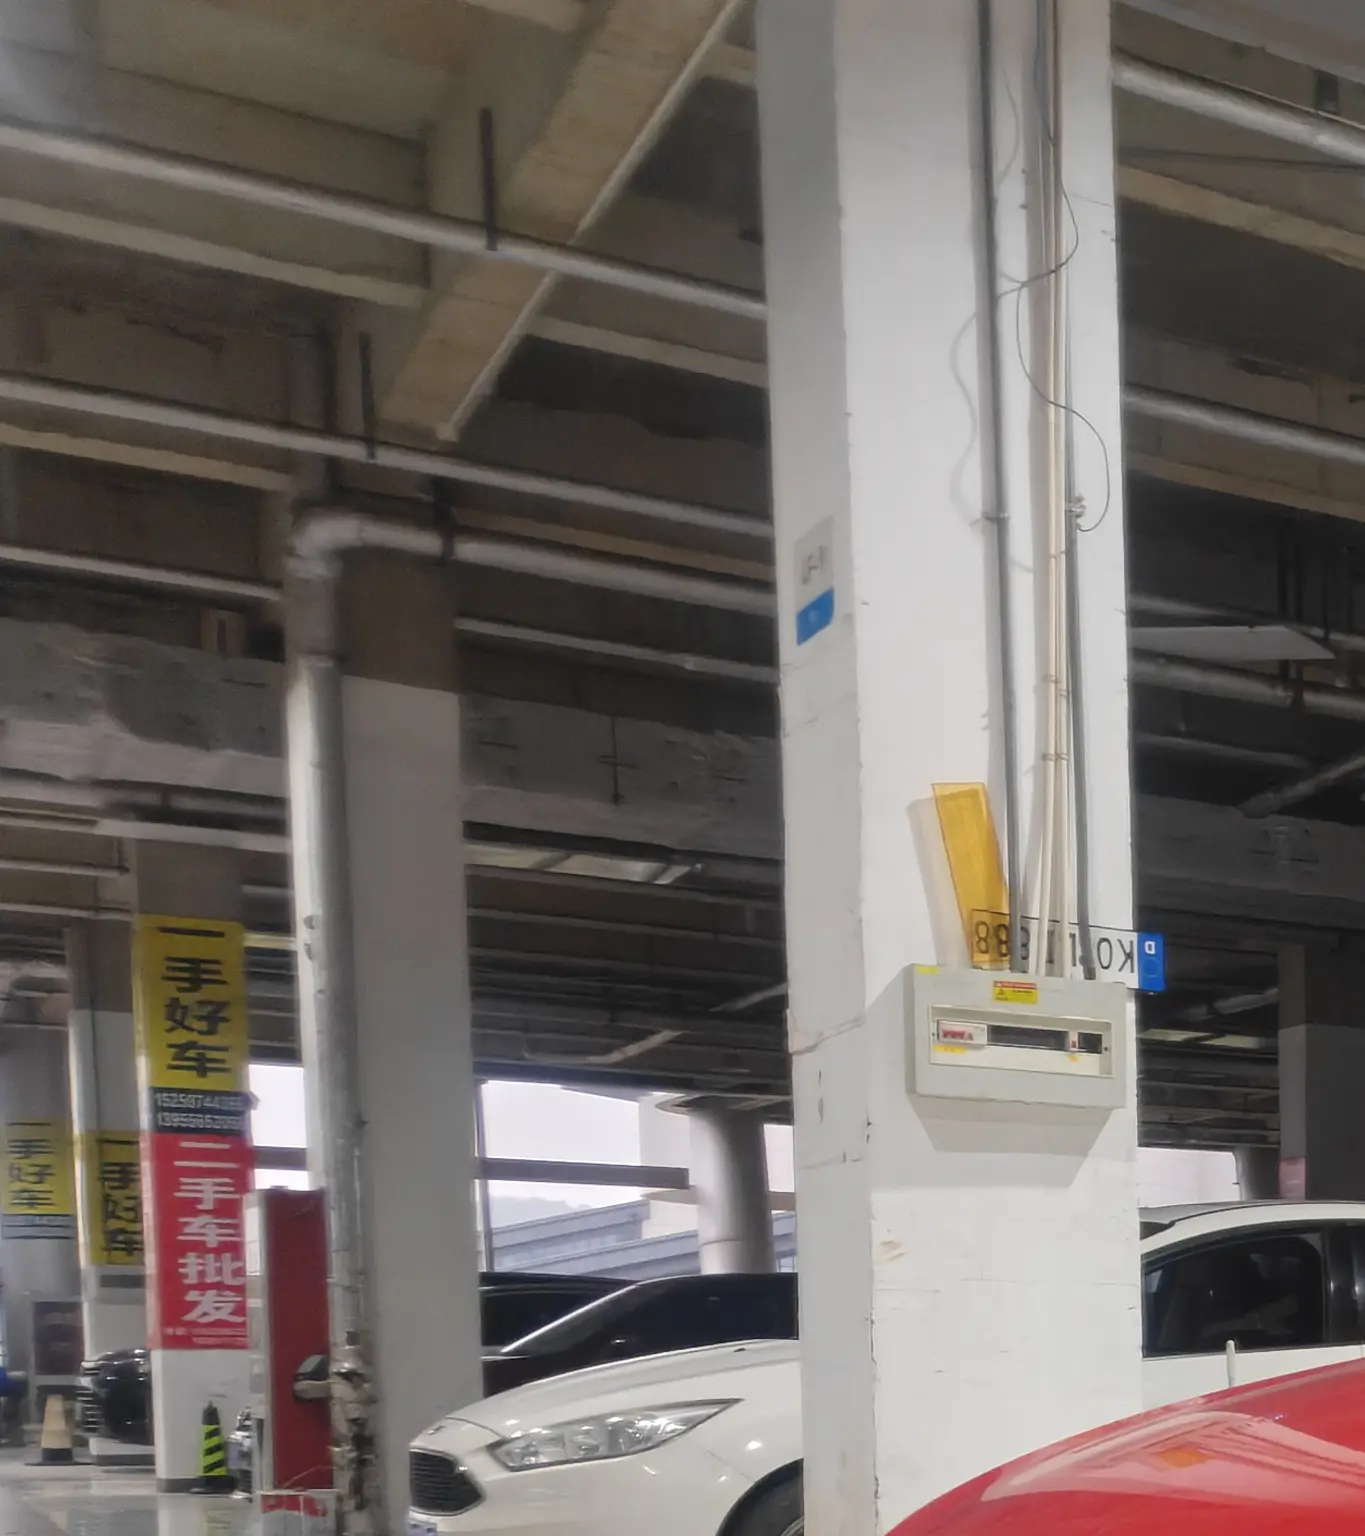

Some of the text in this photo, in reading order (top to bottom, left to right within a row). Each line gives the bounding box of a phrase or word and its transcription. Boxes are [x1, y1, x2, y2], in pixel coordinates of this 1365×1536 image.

[157, 926, 231, 1078] 一手好车
[172, 1141, 246, 1324] 二手车批发
